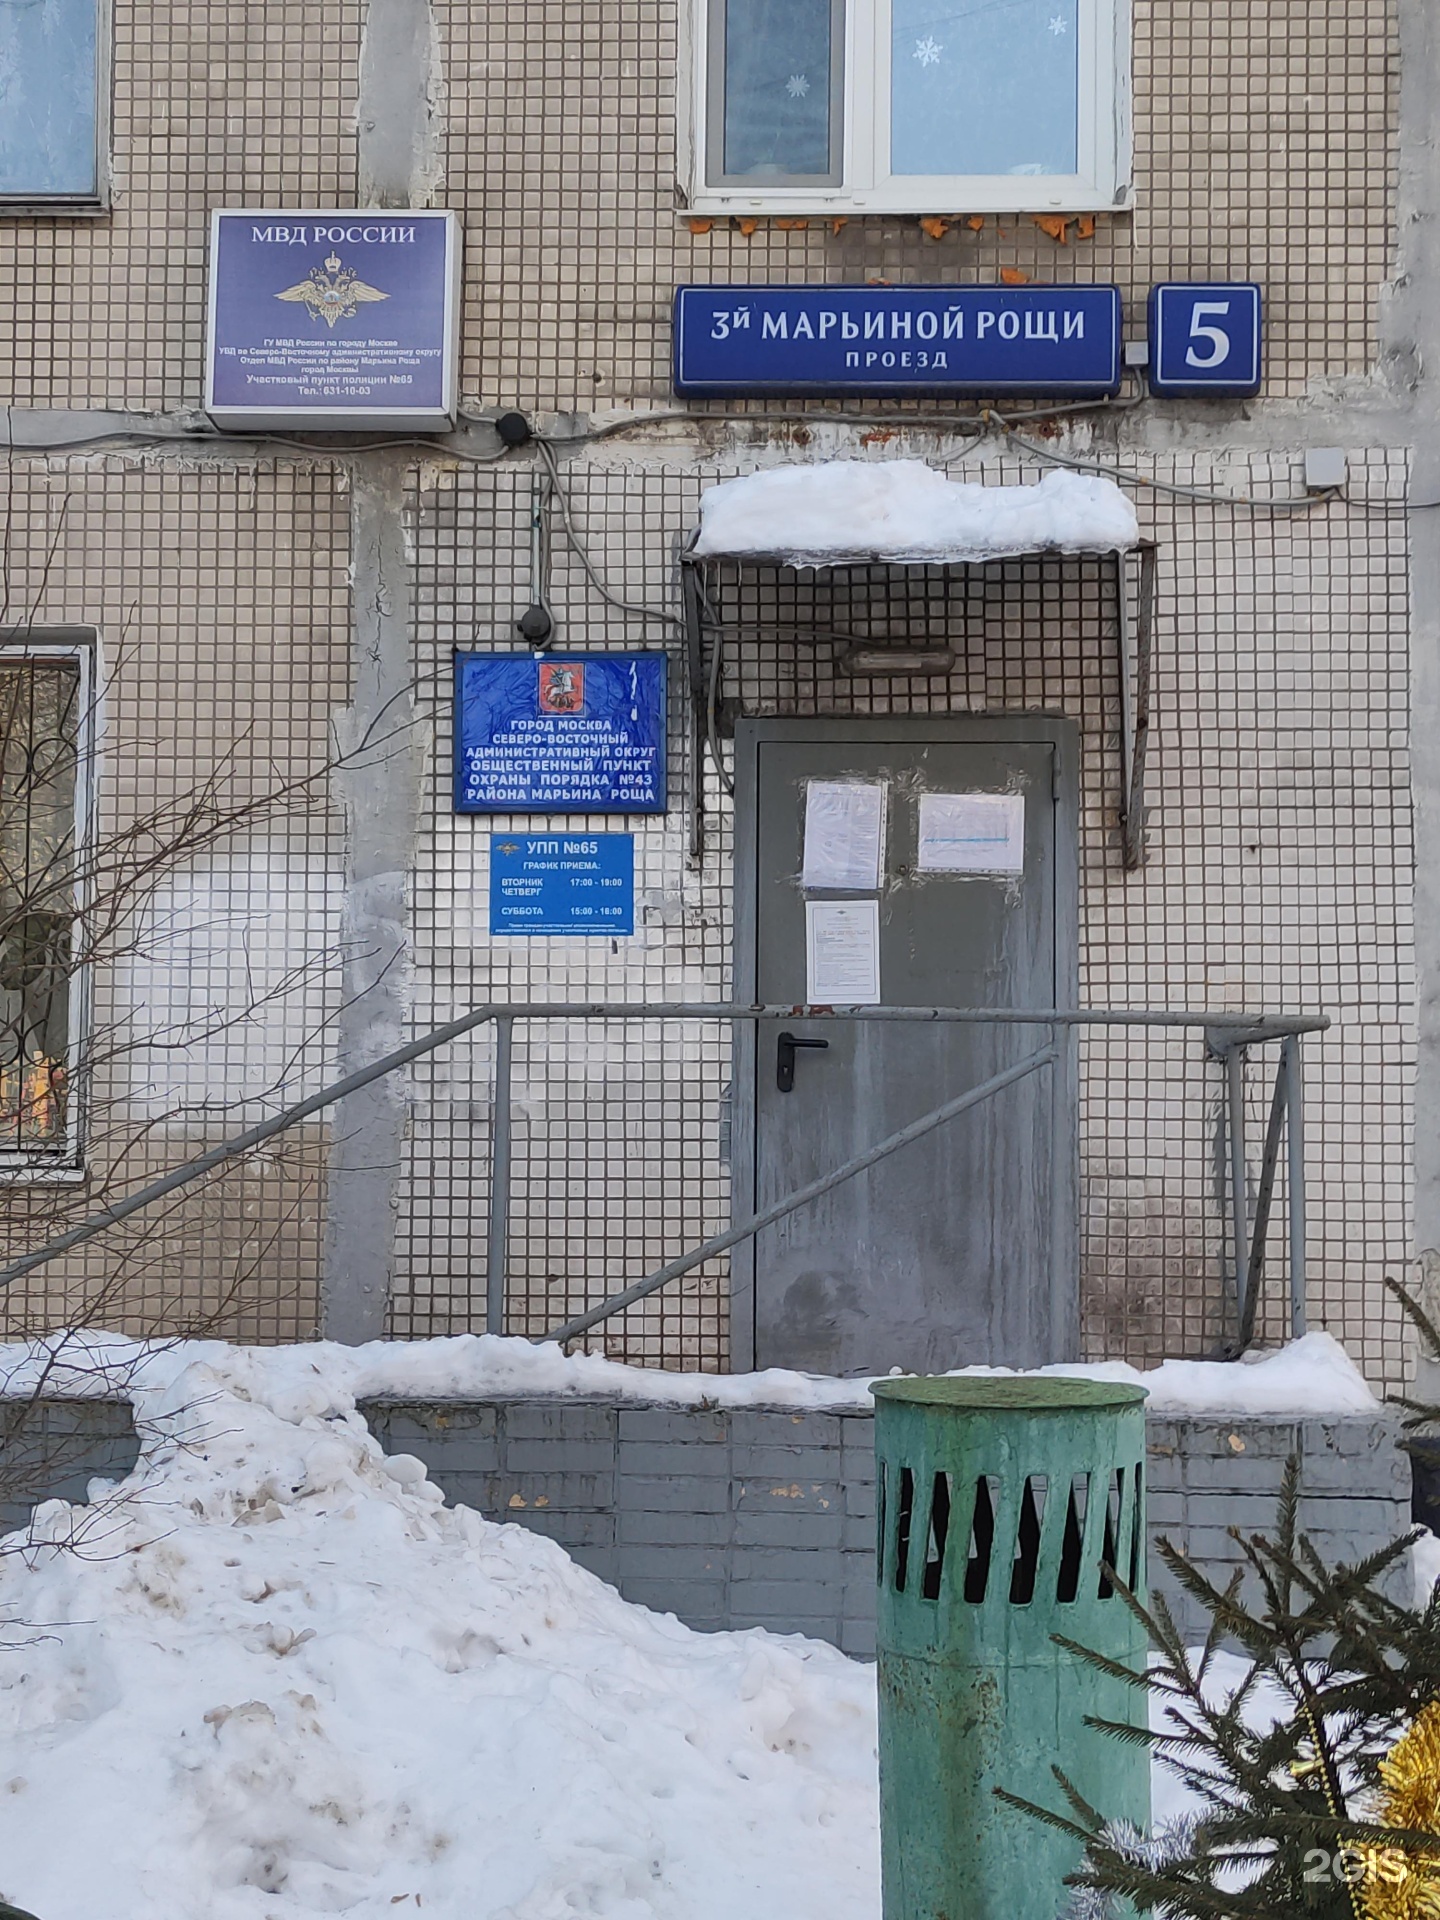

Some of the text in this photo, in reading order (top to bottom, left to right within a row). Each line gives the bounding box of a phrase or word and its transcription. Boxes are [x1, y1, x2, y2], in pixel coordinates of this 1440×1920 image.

[251, 226, 416, 246] МВД РОССИИ
[761, 304, 965, 340] МАРЬИНОЙ
[976, 310, 1085, 345] РОЩИ
[1185, 301, 1230, 367] 5
[264, 339, 274, 347] ГУ
[276, 339, 294, 348] МВД
[338, 340, 366, 348] городу
[416, 348, 442, 356] округу
[240, 356, 265, 364] Отдел
[267, 356, 286, 366] МВД
[288, 356, 316, 364] России
[330, 357, 359, 366] району
[360, 357, 397, 366] Марьина
[845, 350, 949, 370] ПРОЕЗД
[301, 366, 325, 374] город
[246, 374, 413, 384] Участковый пункт полиции №65
[298, 386, 371, 395] Тел.: 631-10-03
[510, 720, 612, 732] ГОРОД МОСКВА
[492, 732, 628, 744] СЕВЕРО-ВОСТОЧНЫЙ
[466, 745, 656, 758] АДМИНИСТРАТИВНЫЙ ОКРУГ
[470, 758, 651, 773] ОБЩЕСТВЕННЫЙ ПУНКТ
[469, 774, 653, 787] ОХРАНЫ ПОРЯДКА №43
[467, 786, 654, 801] РАЙОНА МАРЬИНА РОЩА
[526, 841, 598, 854] УПП №65
[523, 862, 558, 870] ГРАФИК
[502, 878, 543, 886] ВТОРНИК
[570, 878, 592, 886] 17:00
[600, 878, 622, 886] 19:00
[502, 888, 542, 896] ЧЕТВЕРГ
[501, 907, 544, 916] СУББОТА
[570, 907, 592, 915] 15:00
